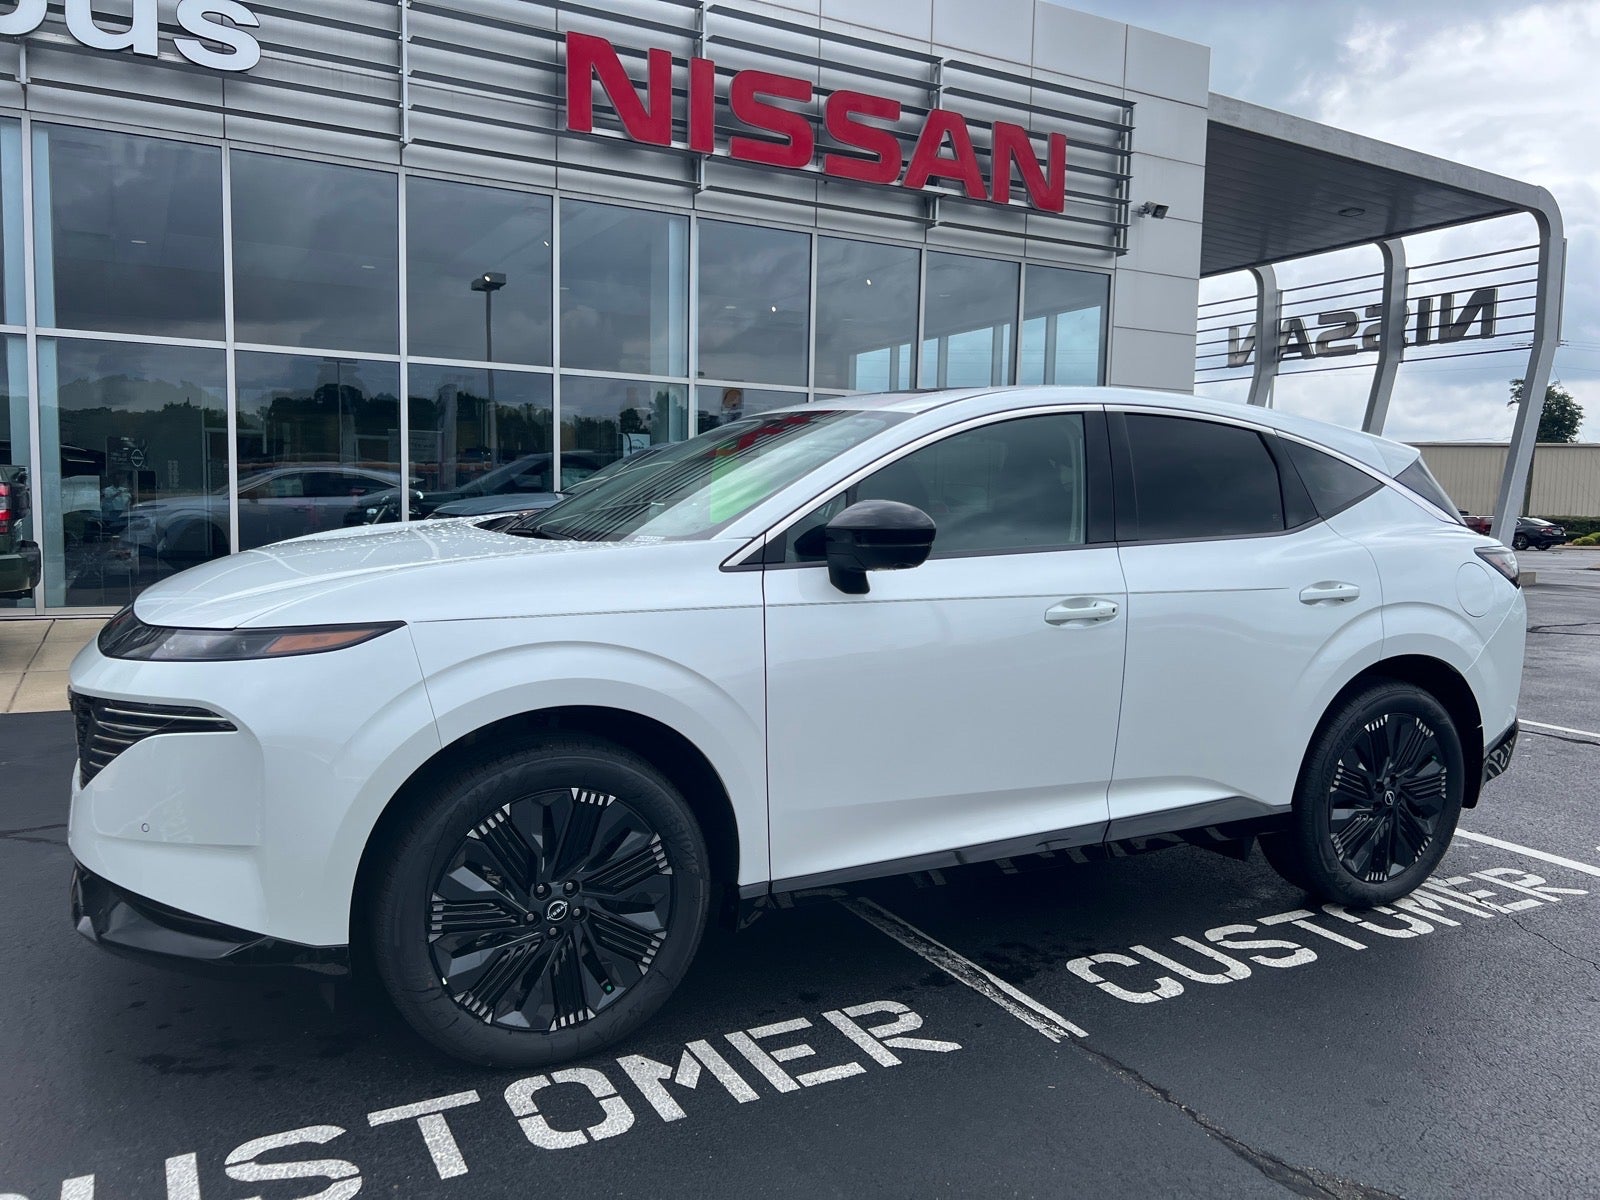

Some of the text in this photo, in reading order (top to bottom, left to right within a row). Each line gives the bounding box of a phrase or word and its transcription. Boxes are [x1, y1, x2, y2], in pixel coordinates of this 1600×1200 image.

[0, 0, 261, 71] us
[566, 31, 1066, 213] NISSAN
[0, 1000, 962, 1200] STOMER
